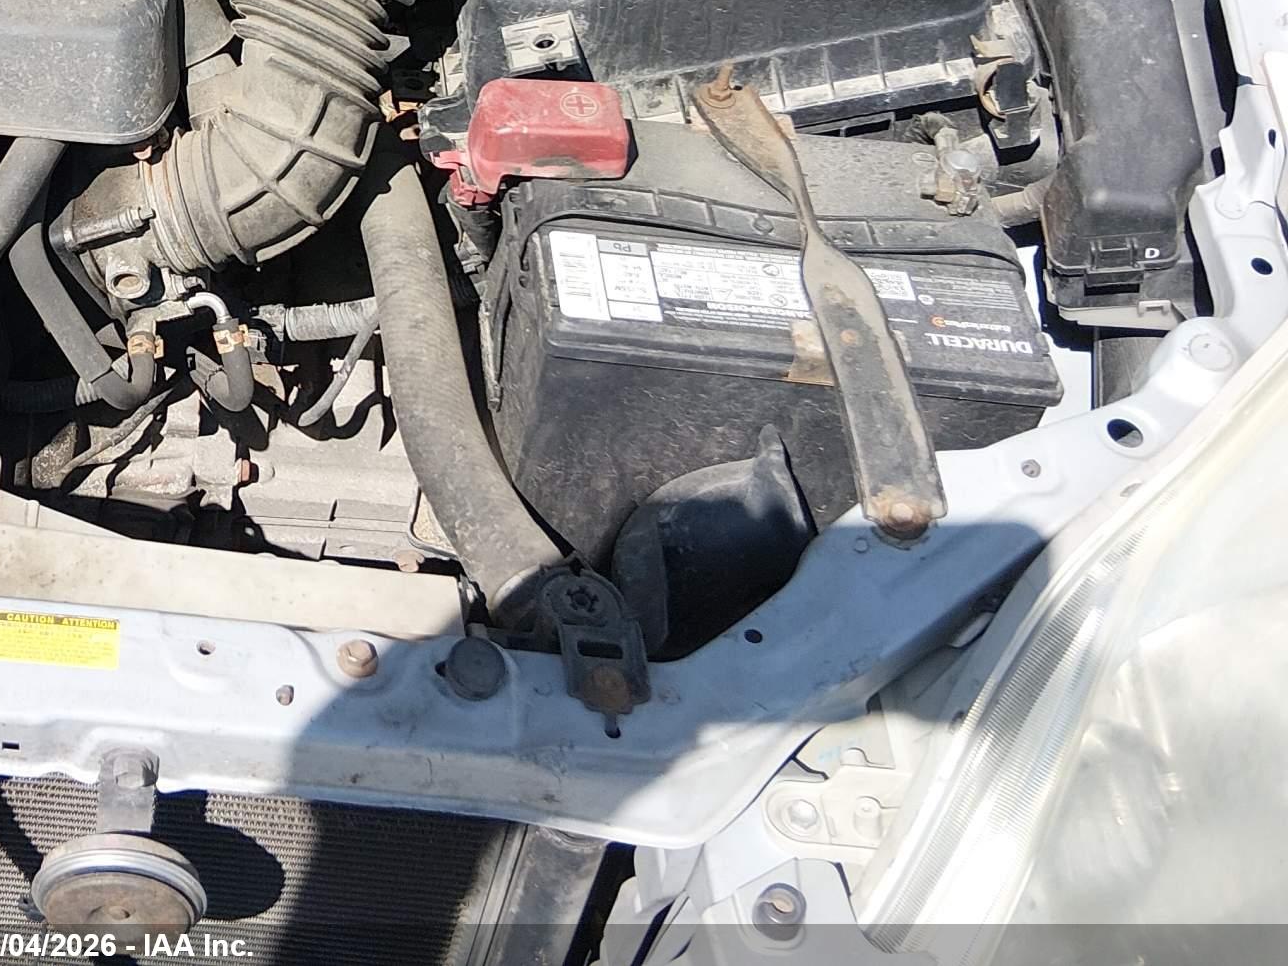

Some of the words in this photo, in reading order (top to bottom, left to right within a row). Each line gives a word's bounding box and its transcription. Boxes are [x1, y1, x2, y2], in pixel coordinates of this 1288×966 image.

[1144, 247, 1160, 259] D
[924, 332, 1034, 354] DURACELL
[6, 613, 55, 624] CAUTION
[62, 618, 116, 629] ATTENTION
